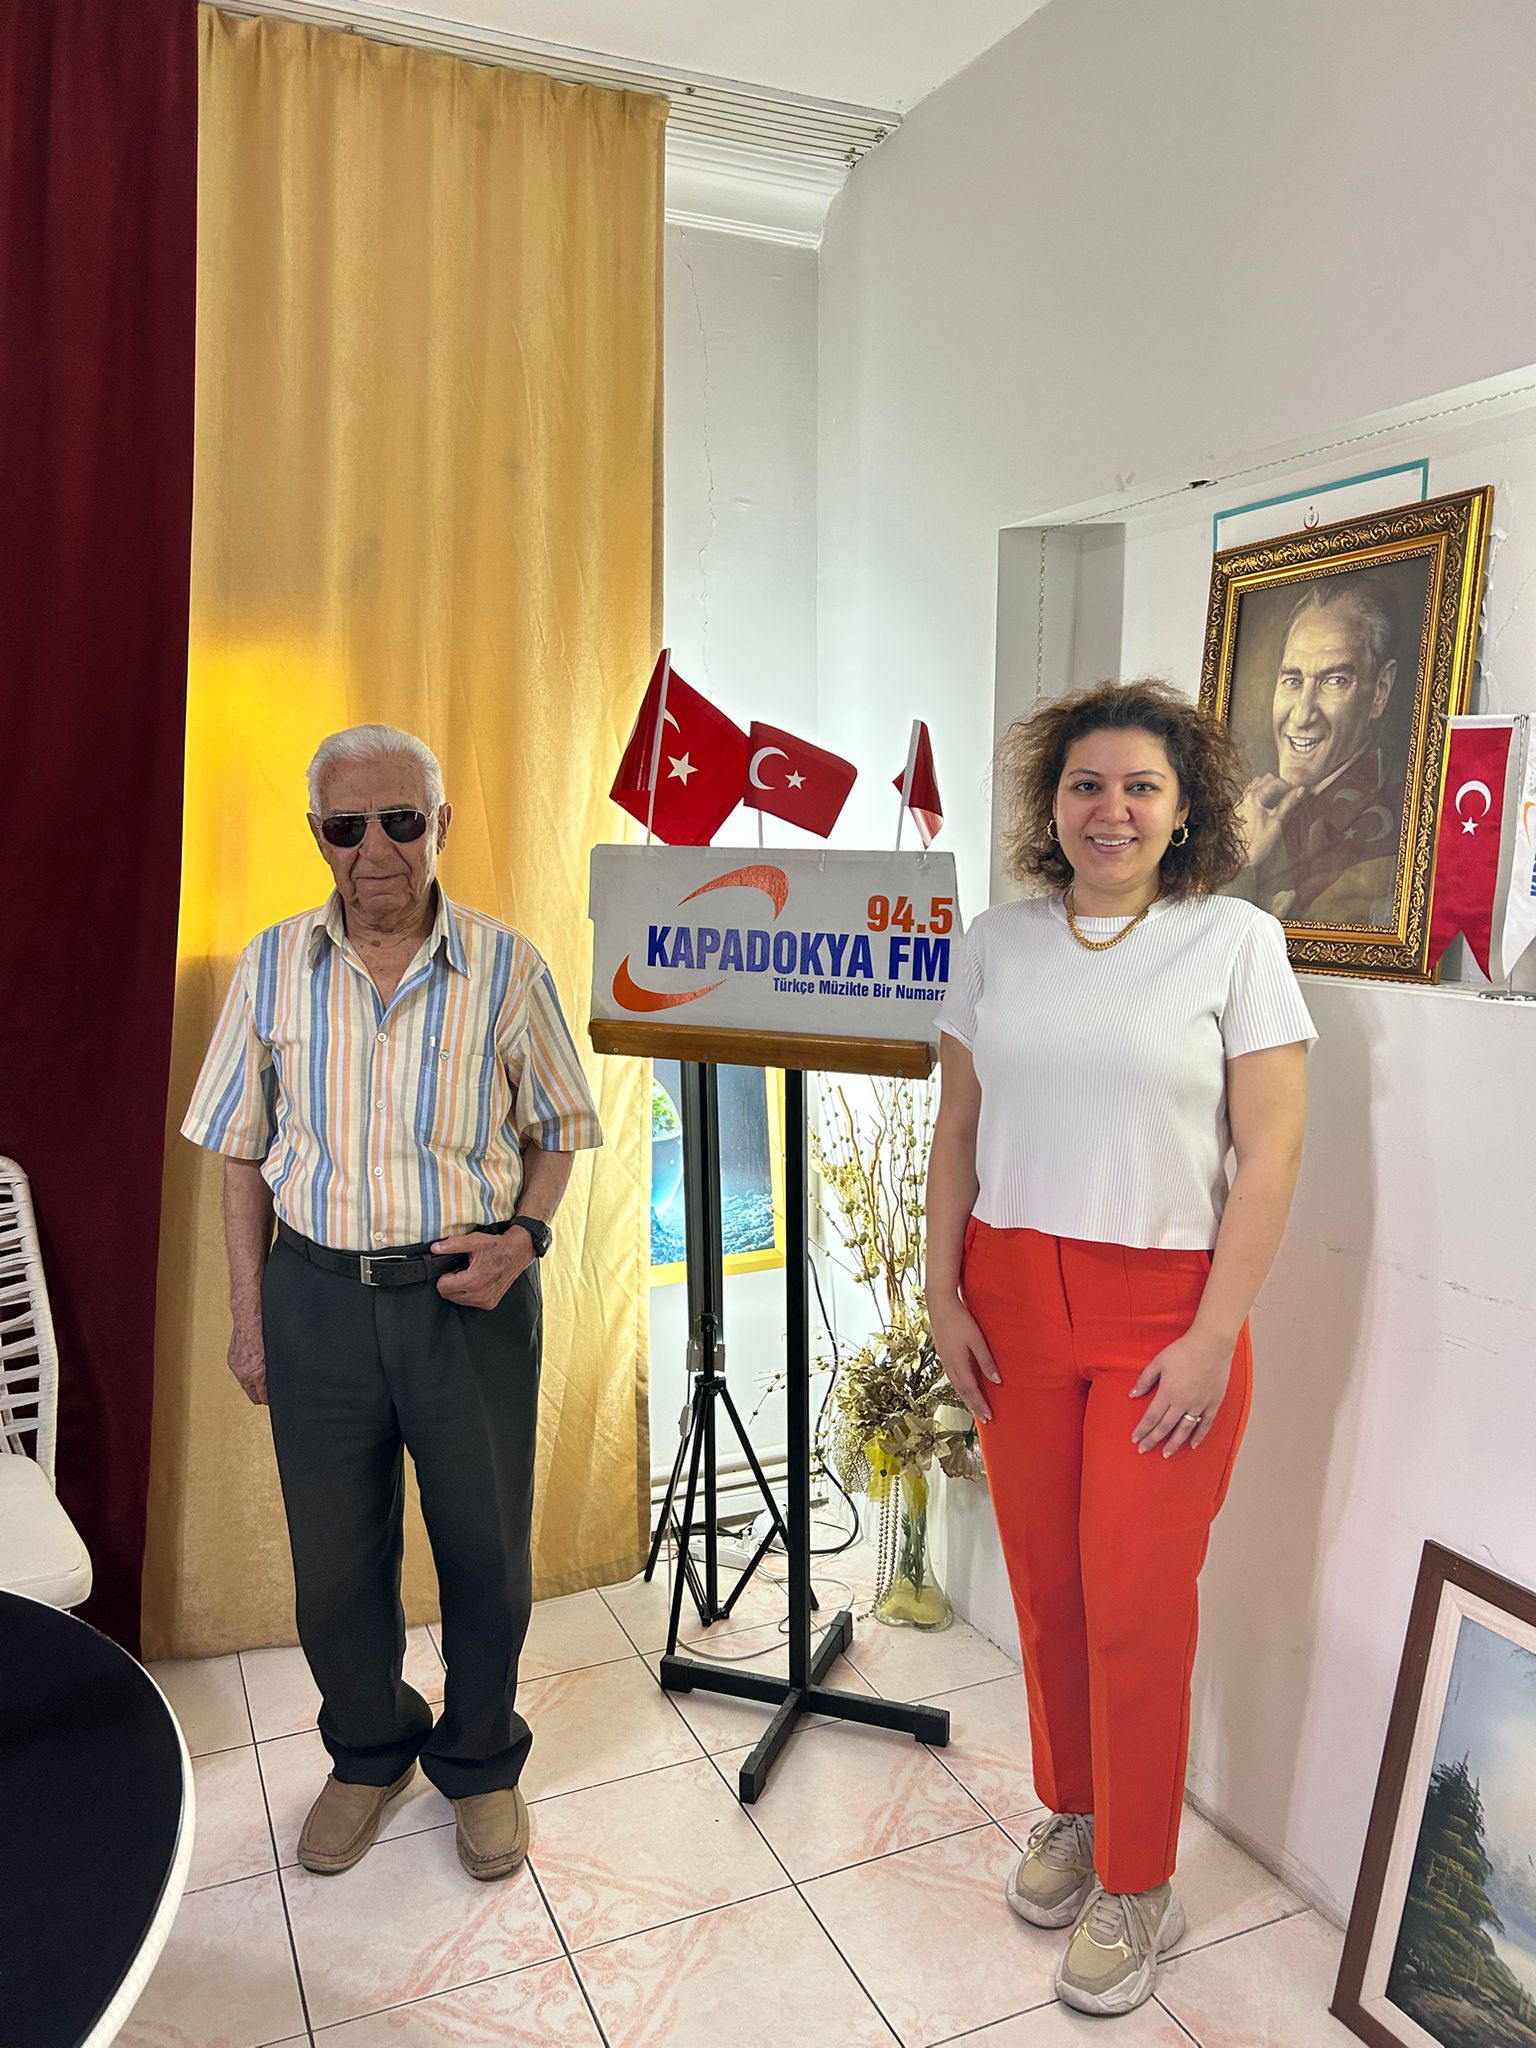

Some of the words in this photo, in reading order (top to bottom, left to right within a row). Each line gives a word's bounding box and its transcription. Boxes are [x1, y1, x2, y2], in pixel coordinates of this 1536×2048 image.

[866, 894, 954, 935] 94.5
[647, 925, 874, 979] KAPADOKYA
[888, 935, 951, 983] FM
[773, 977, 815, 995] Türkçe
[819, 980, 869, 997] Müzikte
[873, 983, 892, 998] Bir
